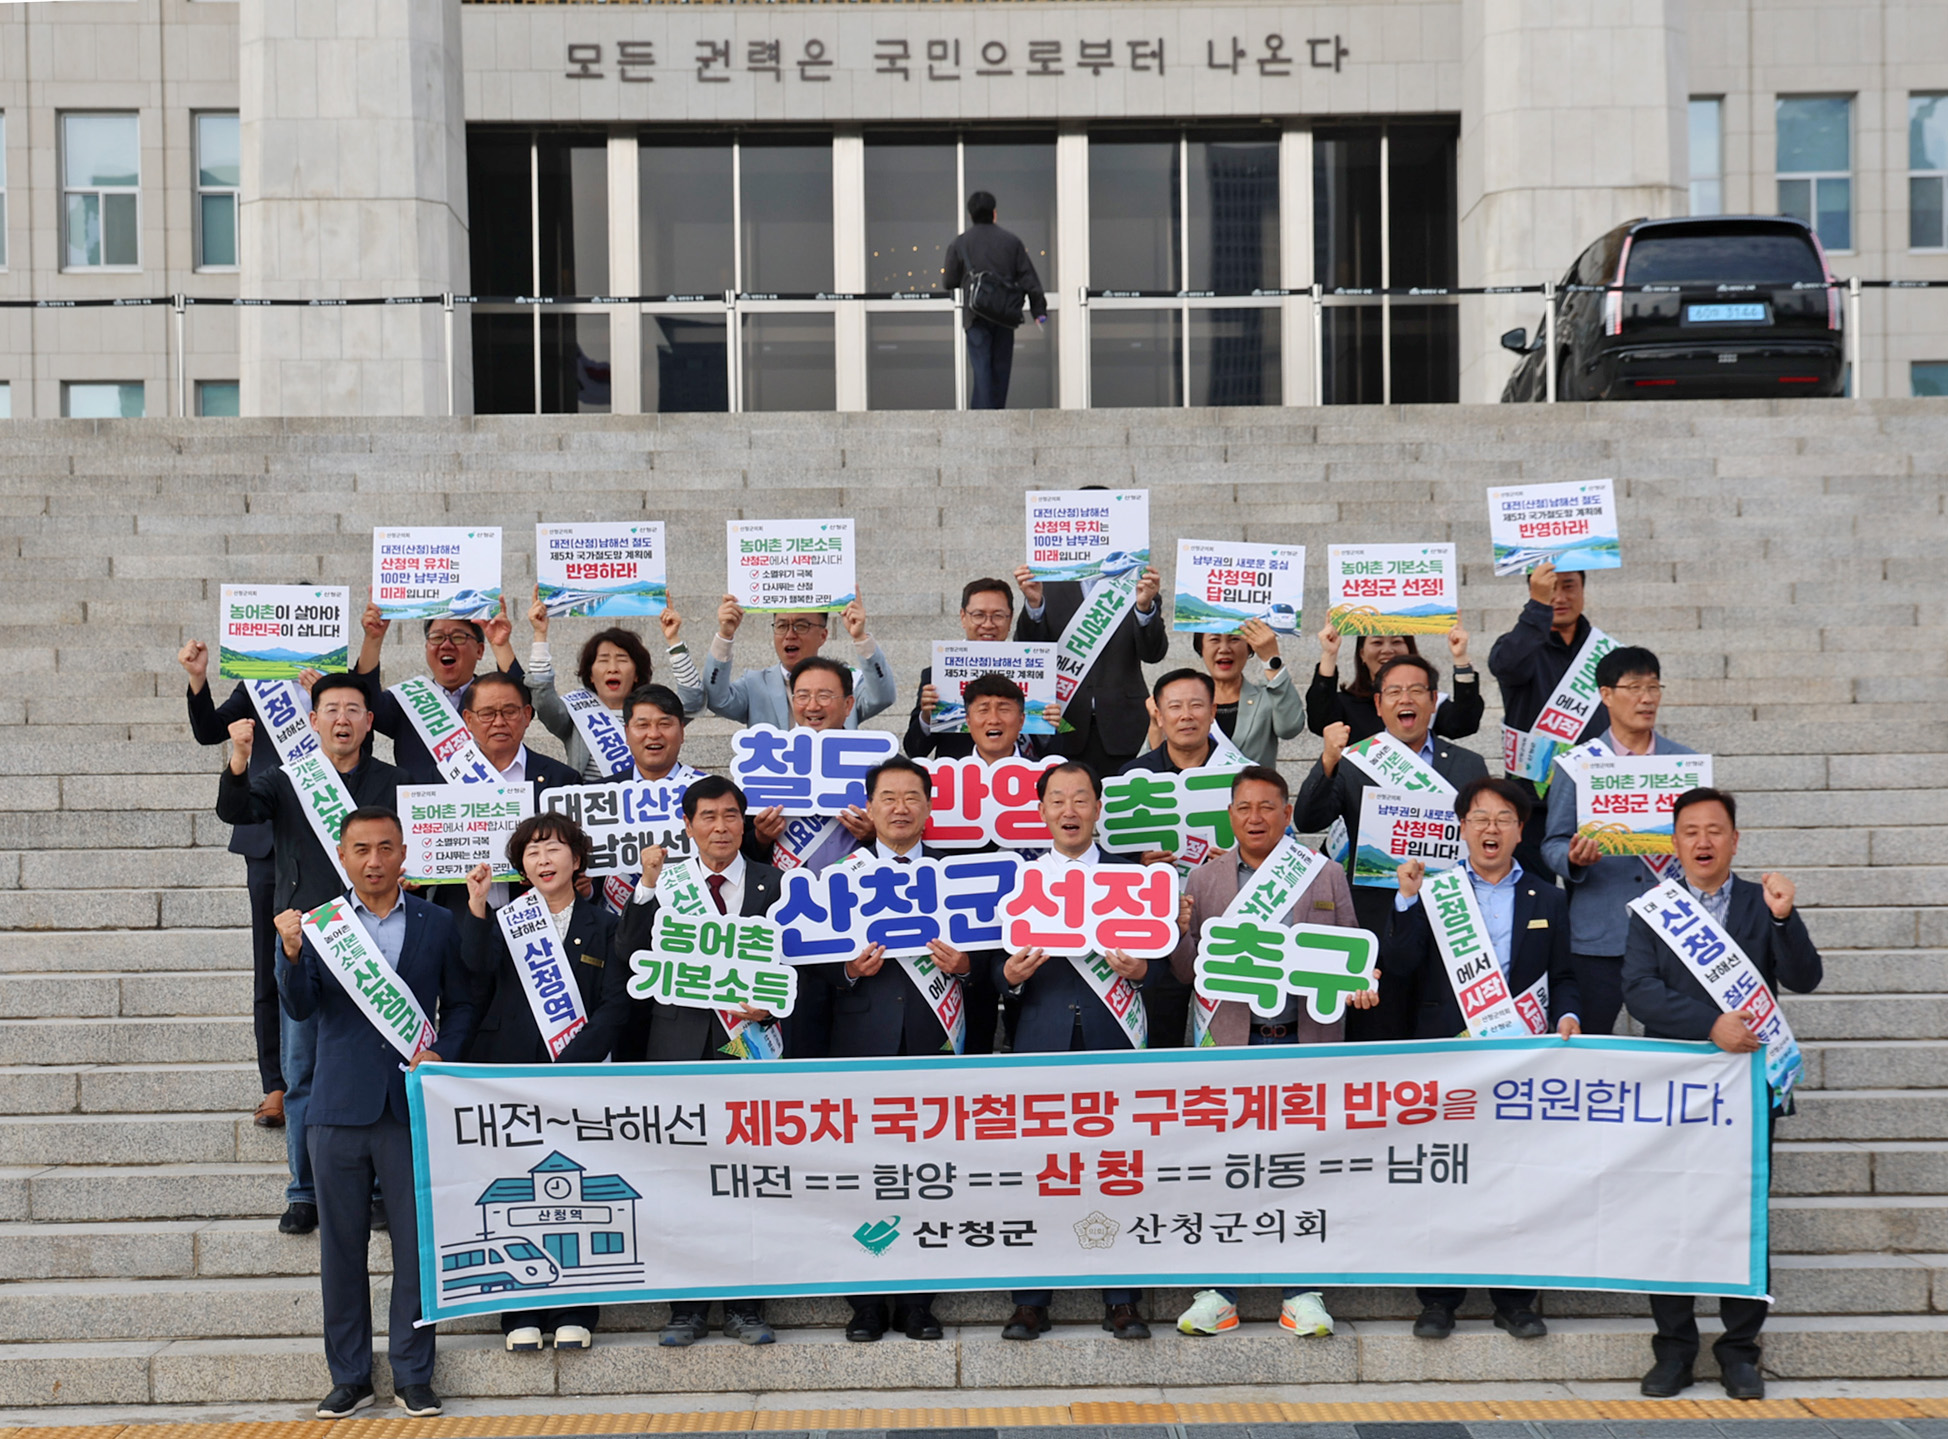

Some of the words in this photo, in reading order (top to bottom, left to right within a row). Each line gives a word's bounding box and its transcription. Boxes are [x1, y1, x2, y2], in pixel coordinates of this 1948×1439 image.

[566, 41, 656, 82] 모든
[694, 38, 833, 82] 권력은
[872, 36, 1166, 82] 국민으로부터
[1206, 33, 1350, 77] 나온다
[1034, 520, 1071, 533] 산청역
[1075, 520, 1109, 533] 유치는
[1519, 519, 1590, 539] 반영하라!
[632, 537, 652, 548] 철도
[740, 538, 782, 553] 농어촌
[786, 537, 842, 552] 기본소득
[1034, 535, 1063, 546] 100만
[1066, 535, 1109, 546] 남부권의
[381, 558, 420, 570] 산청역
[424, 558, 460, 570] 유치는
[550, 551, 574, 561] 제5차
[577, 550, 622, 560] 국가철도망
[625, 550, 652, 560] 계획에
[740, 555, 789, 566] 산청군에서
[791, 555, 842, 565] 시작합시다!
[1034, 549, 1090, 562] 미래입니다!
[1192, 555, 1233, 567] 남부권의
[1235, 558, 1266, 569] 새로운
[1268, 560, 1289, 570] 중심
[566, 562, 637, 579] 반영하라!
[1341, 561, 1383, 575] 농어촌
[1387, 560, 1443, 574] 기본소득
[380, 572, 411, 584] 100만
[414, 572, 460, 584] 남부권의
[1207, 568, 1273, 588] 산청역이
[1342, 578, 1397, 597] 산청군
[1402, 578, 1443, 597] 선정!
[380, 587, 439, 599] 미래입니다!
[763, 595, 787, 604] 모두가
[815, 594, 831, 603] 군민
[1206, 586, 1272, 605] 답입니다!
[230, 603, 290, 620] 농어촌이
[294, 604, 341, 620] 살아야
[228, 622, 293, 637] 대한민국이
[297, 624, 340, 638] 삽니다!
[1025, 657, 1044, 668] 철도
[944, 668, 967, 678] 제5차
[1017, 669, 1044, 679] 계획에
[570, 698, 602, 711] 남해선
[1555, 694, 1589, 717] 에서
[276, 717, 307, 743] 남해선
[1539, 712, 1580, 736] 시작
[737, 730, 892, 809] 철도
[1590, 774, 1635, 790] 농어촌
[1638, 773, 1699, 789] 기본소득
[411, 803, 456, 820] 농어촌
[460, 801, 520, 818] 기본소득
[922, 763, 1060, 840] 반영
[1591, 794, 1649, 814] 산청군
[1104, 773, 1238, 852] 촉구
[1378, 804, 1420, 818] 남부권의
[1423, 808, 1456, 821] 새로운
[411, 822, 464, 834] 산청군에서
[1392, 819, 1460, 841] 산청역이
[435, 837, 470, 847] 소멸위기
[472, 836, 490, 846] 극복
[1390, 838, 1460, 860] 답입니다!
[435, 851, 471, 861] 다시뛰는
[436, 865, 463, 875] 모두가
[492, 862, 510, 872] 군민
[672, 882, 707, 915] 산
[774, 859, 1017, 958] 산청군
[1005, 867, 1171, 951] 선정
[1430, 874, 1481, 958] 산청군
[509, 918, 549, 940] 남해선
[1660, 899, 1727, 967] 산청
[660, 915, 774, 964] 농어촌
[1202, 921, 1370, 1016] 촉구
[1455, 952, 1492, 985] 에서
[1704, 952, 1743, 984] 남해선
[524, 936, 577, 1023] 산청역
[636, 958, 790, 1010] 기본소득
[1465, 975, 1503, 1014] 시작
[1722, 970, 1758, 1010] 철도
[353, 958, 422, 1044] 산청군
[454, 1103, 708, 1147] 대전~남해선
[725, 1097, 858, 1146] 제5차
[871, 1090, 1120, 1143] 국가철도망
[1132, 1082, 1327, 1137] 구축계획
[1344, 1080, 1478, 1130] 반영을
[1493, 1077, 1734, 1127] 염원합니다.
[710, 1163, 793, 1199] 대전
[873, 1161, 957, 1201] 함양
[1036, 1149, 1145, 1197] 산청
[1225, 1151, 1306, 1190] 하동
[1387, 1142, 1469, 1185] 남해
[538, 1208, 583, 1222] 산청역
[912, 1219, 1038, 1248] 산청군
[1126, 1207, 1327, 1245] 산청군의회
